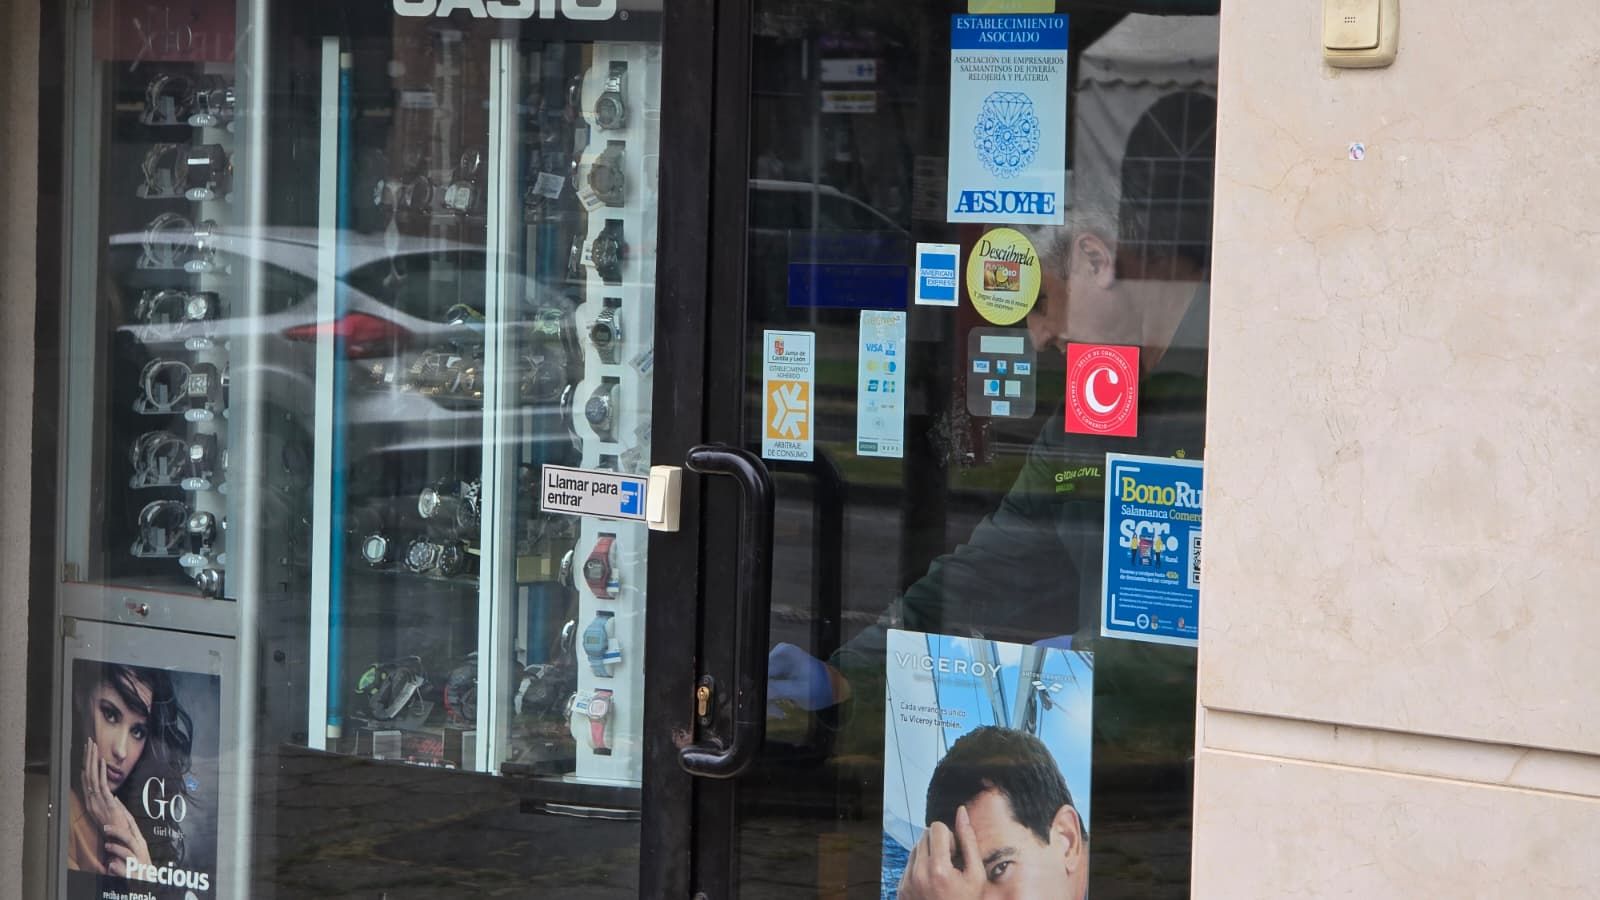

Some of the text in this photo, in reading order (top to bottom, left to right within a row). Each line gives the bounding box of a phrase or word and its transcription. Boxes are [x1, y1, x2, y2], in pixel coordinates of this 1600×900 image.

[957, 17, 1064, 29] ESTABLECIMIENTO
[979, 31, 1040, 43] ASOCIADO
[1014, 57, 1064, 65] EMPRESARIOS
[954, 191, 1055, 215] AESJOYRE
[979, 240, 1035, 266] Descúbrela
[928, 279, 957, 287] EXPRESS
[866, 344, 883, 352] VISA
[1086, 367, 1123, 413] C
[768, 449, 776, 457] DE
[548, 473, 618, 496] Llamar para
[548, 492, 583, 507] entrar
[1121, 504, 1169, 519] Salamanca
[896, 652, 1003, 679] VICEROY
[901, 702, 916, 711] Cada
[918, 706, 940, 714] verano
[901, 714, 908, 722] Tu
[910, 715, 933, 726] Viceroy
[142, 776, 187, 823] Go
[154, 826, 167, 837] Girl
[126, 856, 210, 891] Precious
